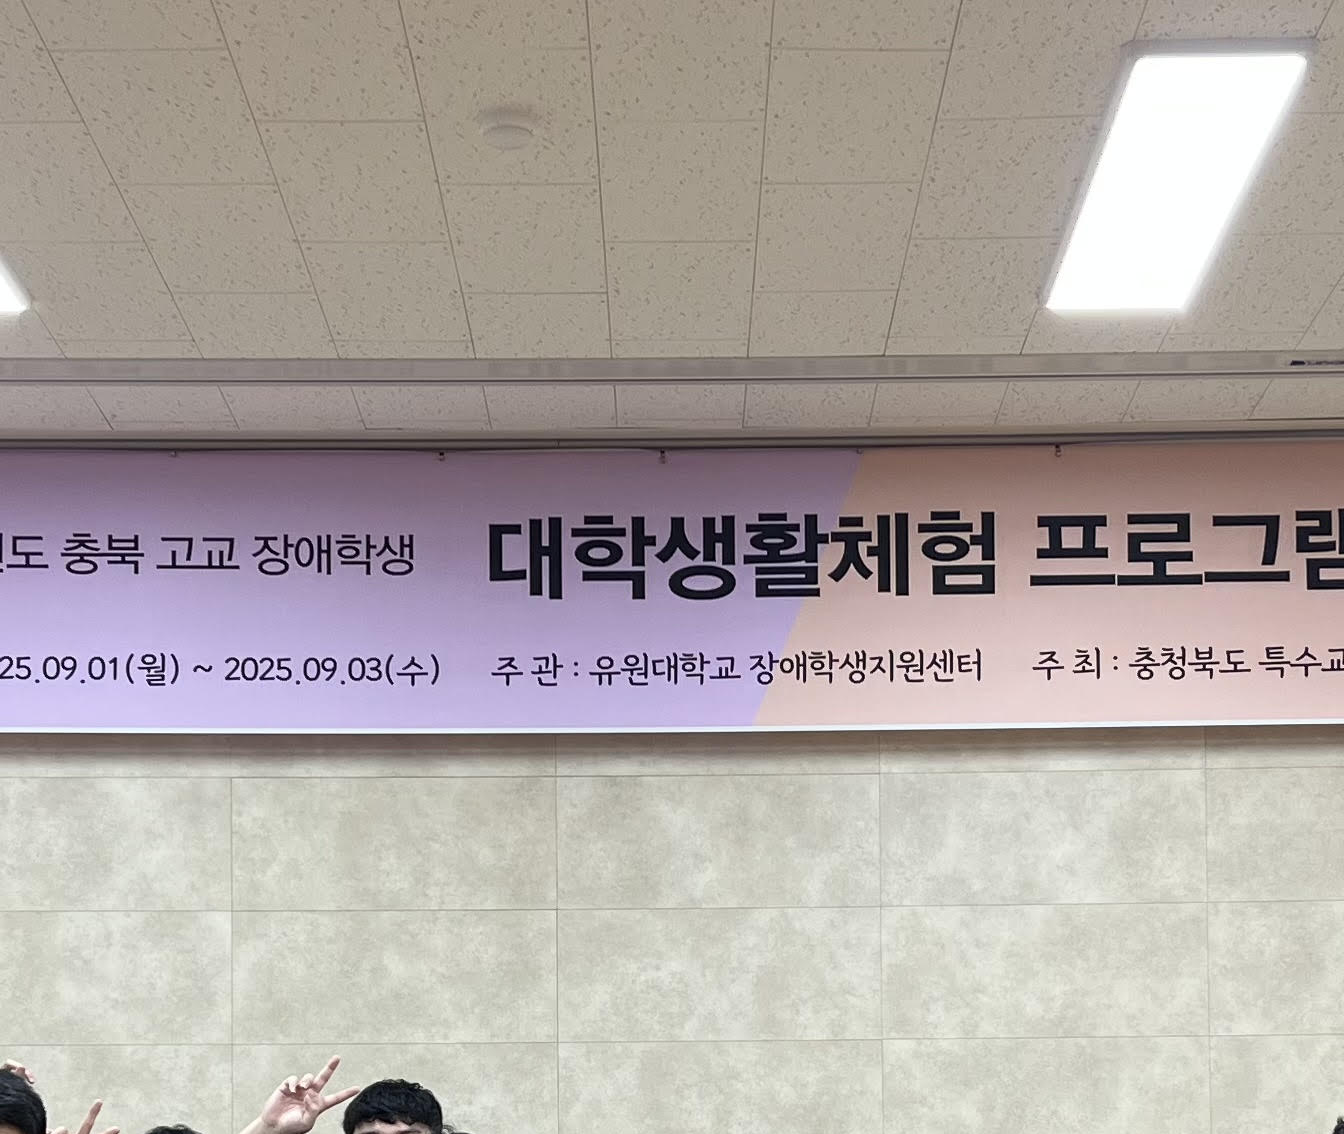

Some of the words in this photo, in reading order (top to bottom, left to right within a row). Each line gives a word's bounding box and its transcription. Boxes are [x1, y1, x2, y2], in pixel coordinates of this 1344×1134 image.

[59, 531, 146, 576] 충북
[154, 535, 242, 571] 고교
[250, 532, 416, 578] 장애학생
[487, 509, 997, 602] 대학생활체험
[223, 652, 441, 688] 2025.09.03(수)
[587, 651, 743, 687] 유원대학교
[748, 648, 983, 687] 장애학생지원센터
[1128, 645, 1252, 682] 충청북도
